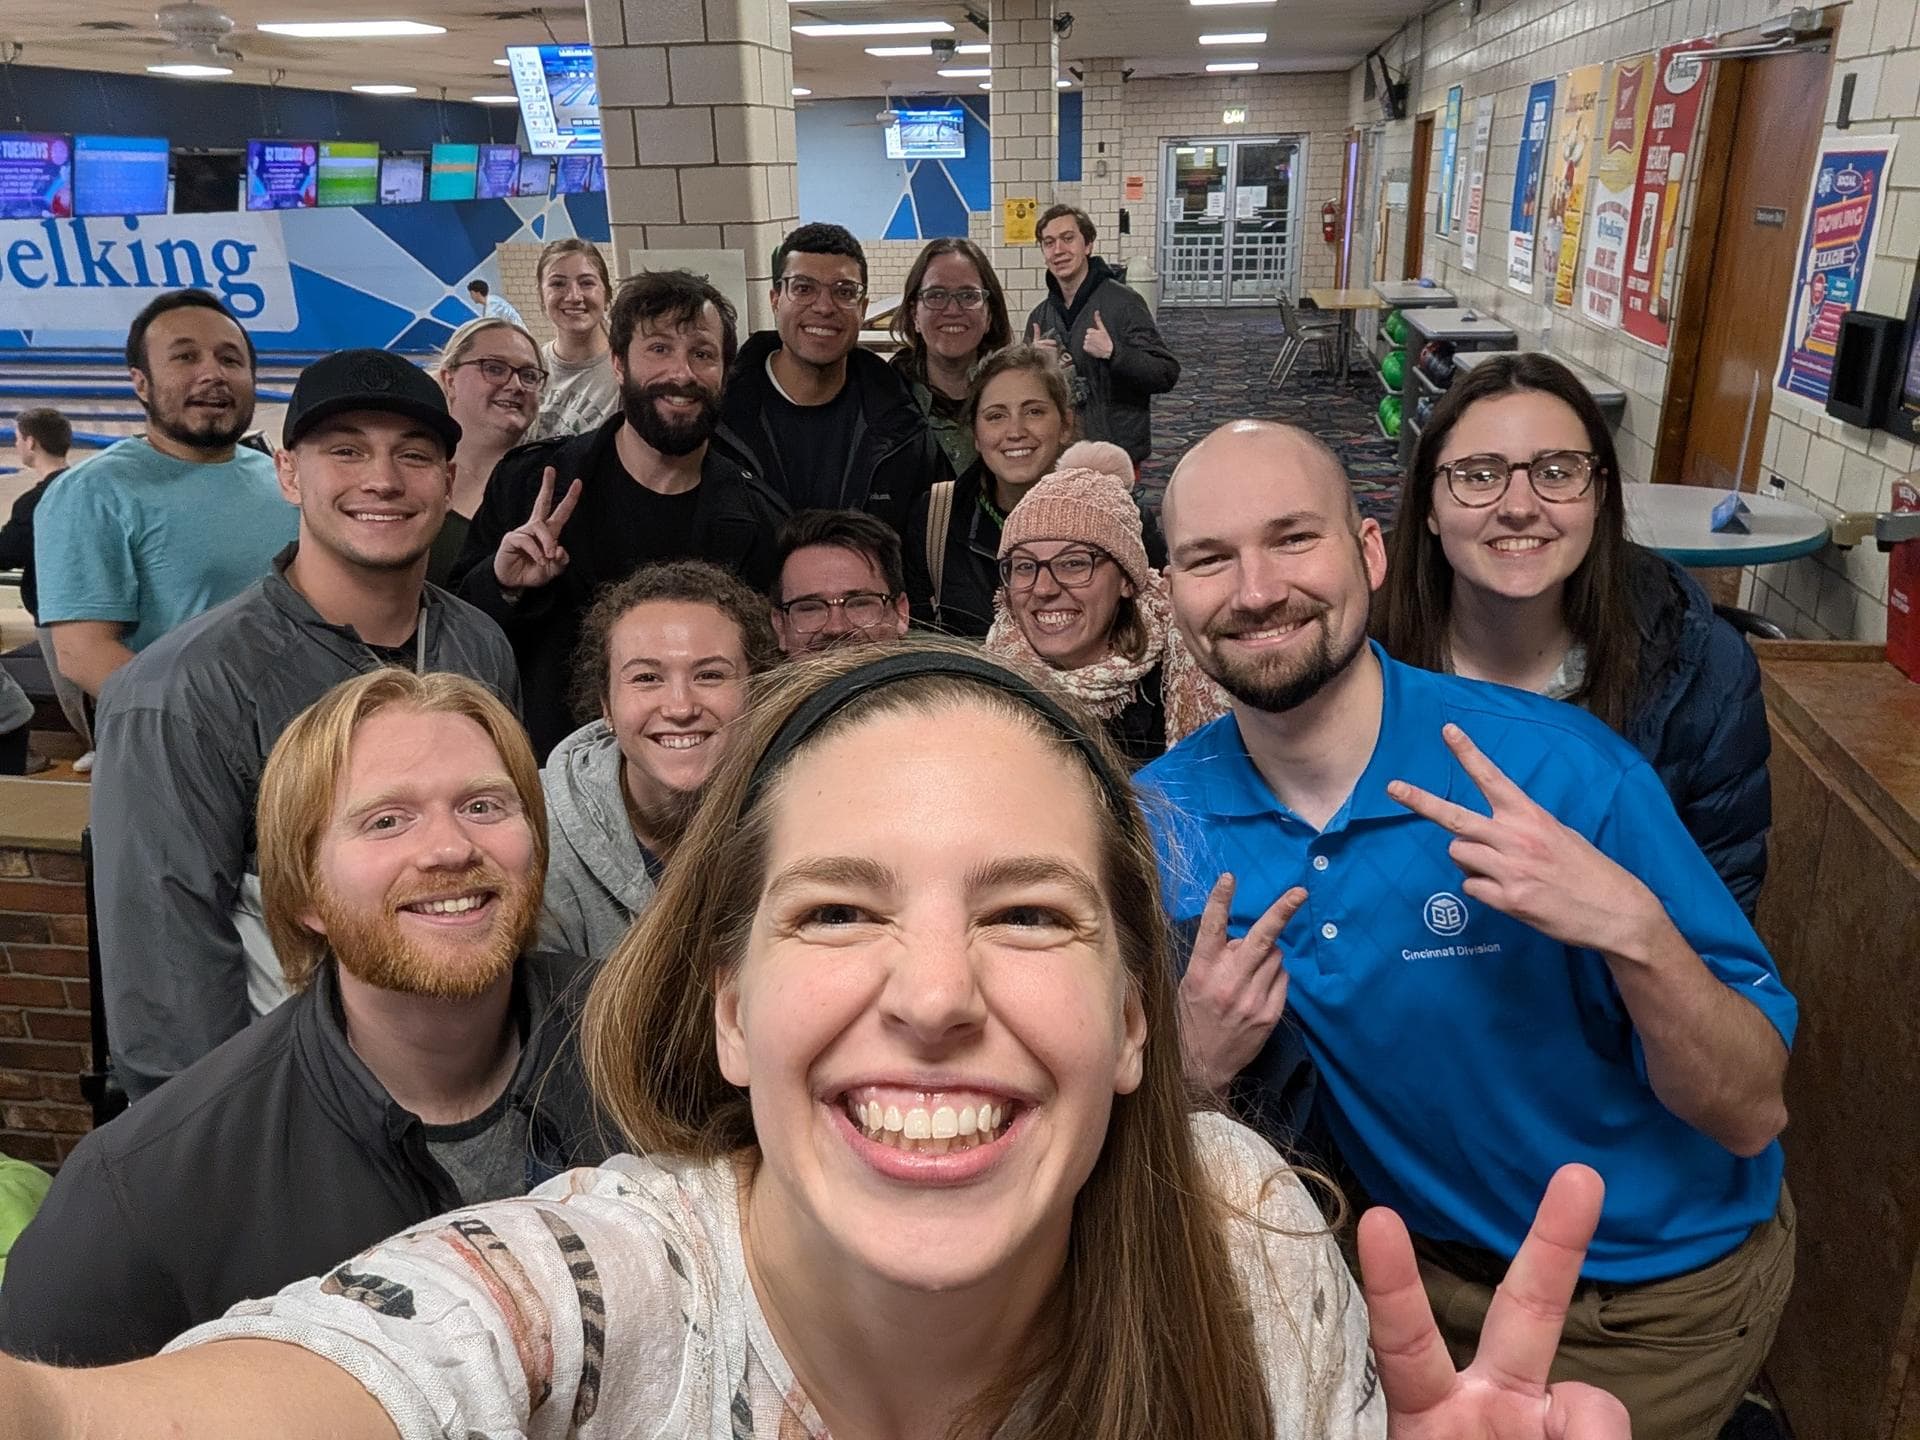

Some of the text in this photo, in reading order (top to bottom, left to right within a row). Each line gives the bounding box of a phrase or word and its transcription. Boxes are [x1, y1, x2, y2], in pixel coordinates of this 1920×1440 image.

[2, 141, 49, 159] TUESDAYS
[1817, 206, 1863, 233] BOWLING
[0, 215, 265, 318] elking
[1457, 942, 1501, 956] Division
